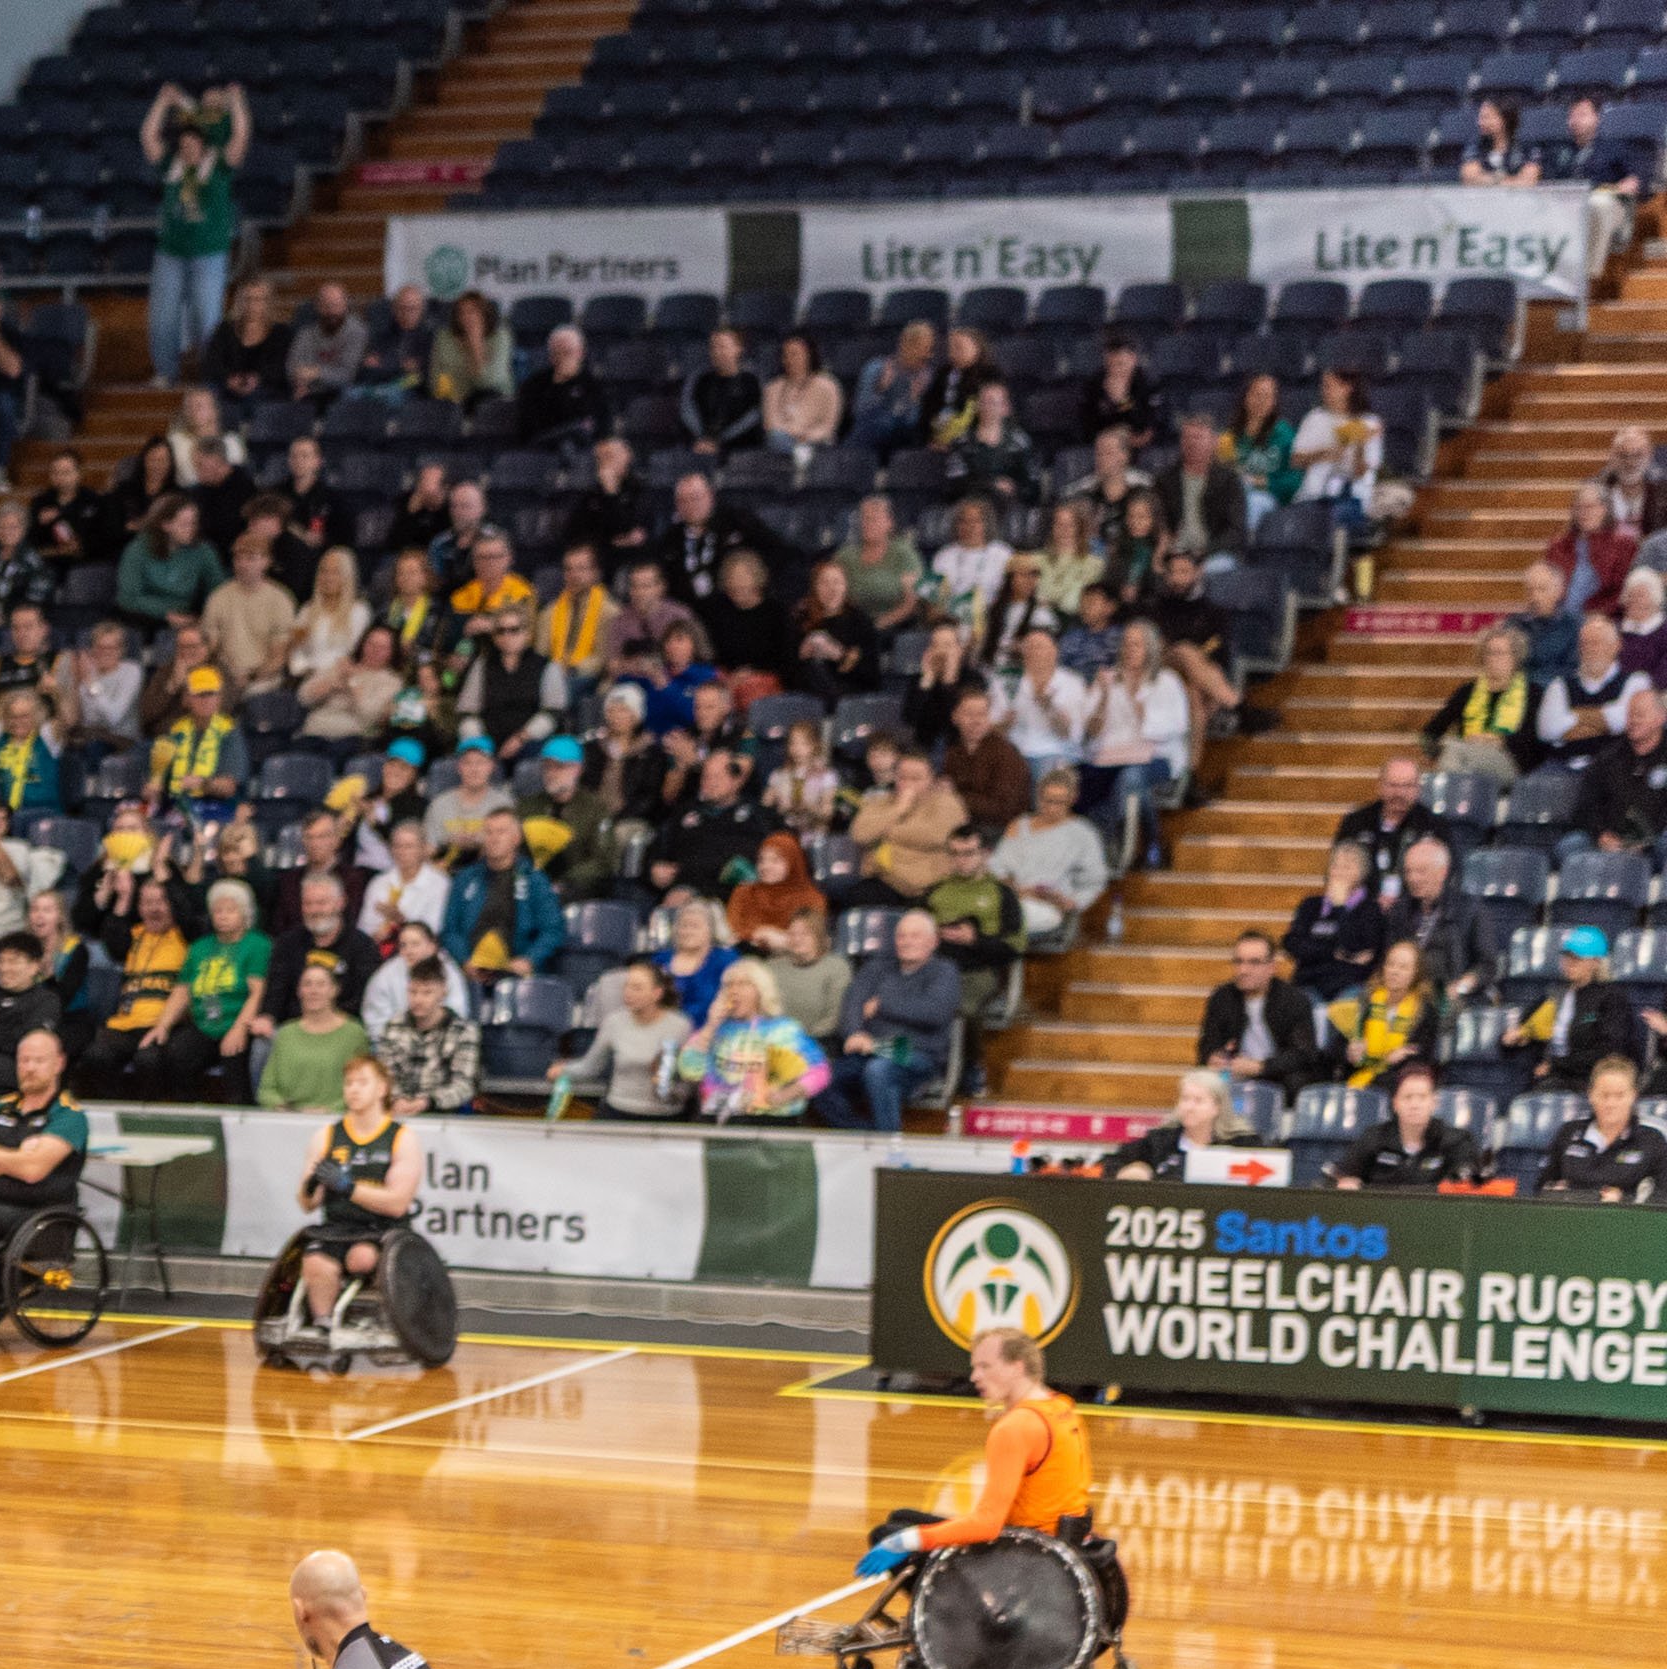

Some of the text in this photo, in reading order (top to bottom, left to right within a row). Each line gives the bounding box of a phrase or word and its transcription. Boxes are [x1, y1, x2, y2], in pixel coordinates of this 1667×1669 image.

[475, 252, 681, 284] Plan Partners
[862, 239, 944, 284] Lite
[998, 238, 1104, 285] Easy
[1314, 226, 1399, 272] Lite
[1456, 226, 1570, 273] Easy
[427, 1152, 491, 1192] lan
[1105, 1206, 1390, 1261] 2025 Santos
[1103, 1252, 1667, 1331] WHEELCHAIR RUGBY
[1103, 1304, 1667, 1388] WORLD CHALLENGE
